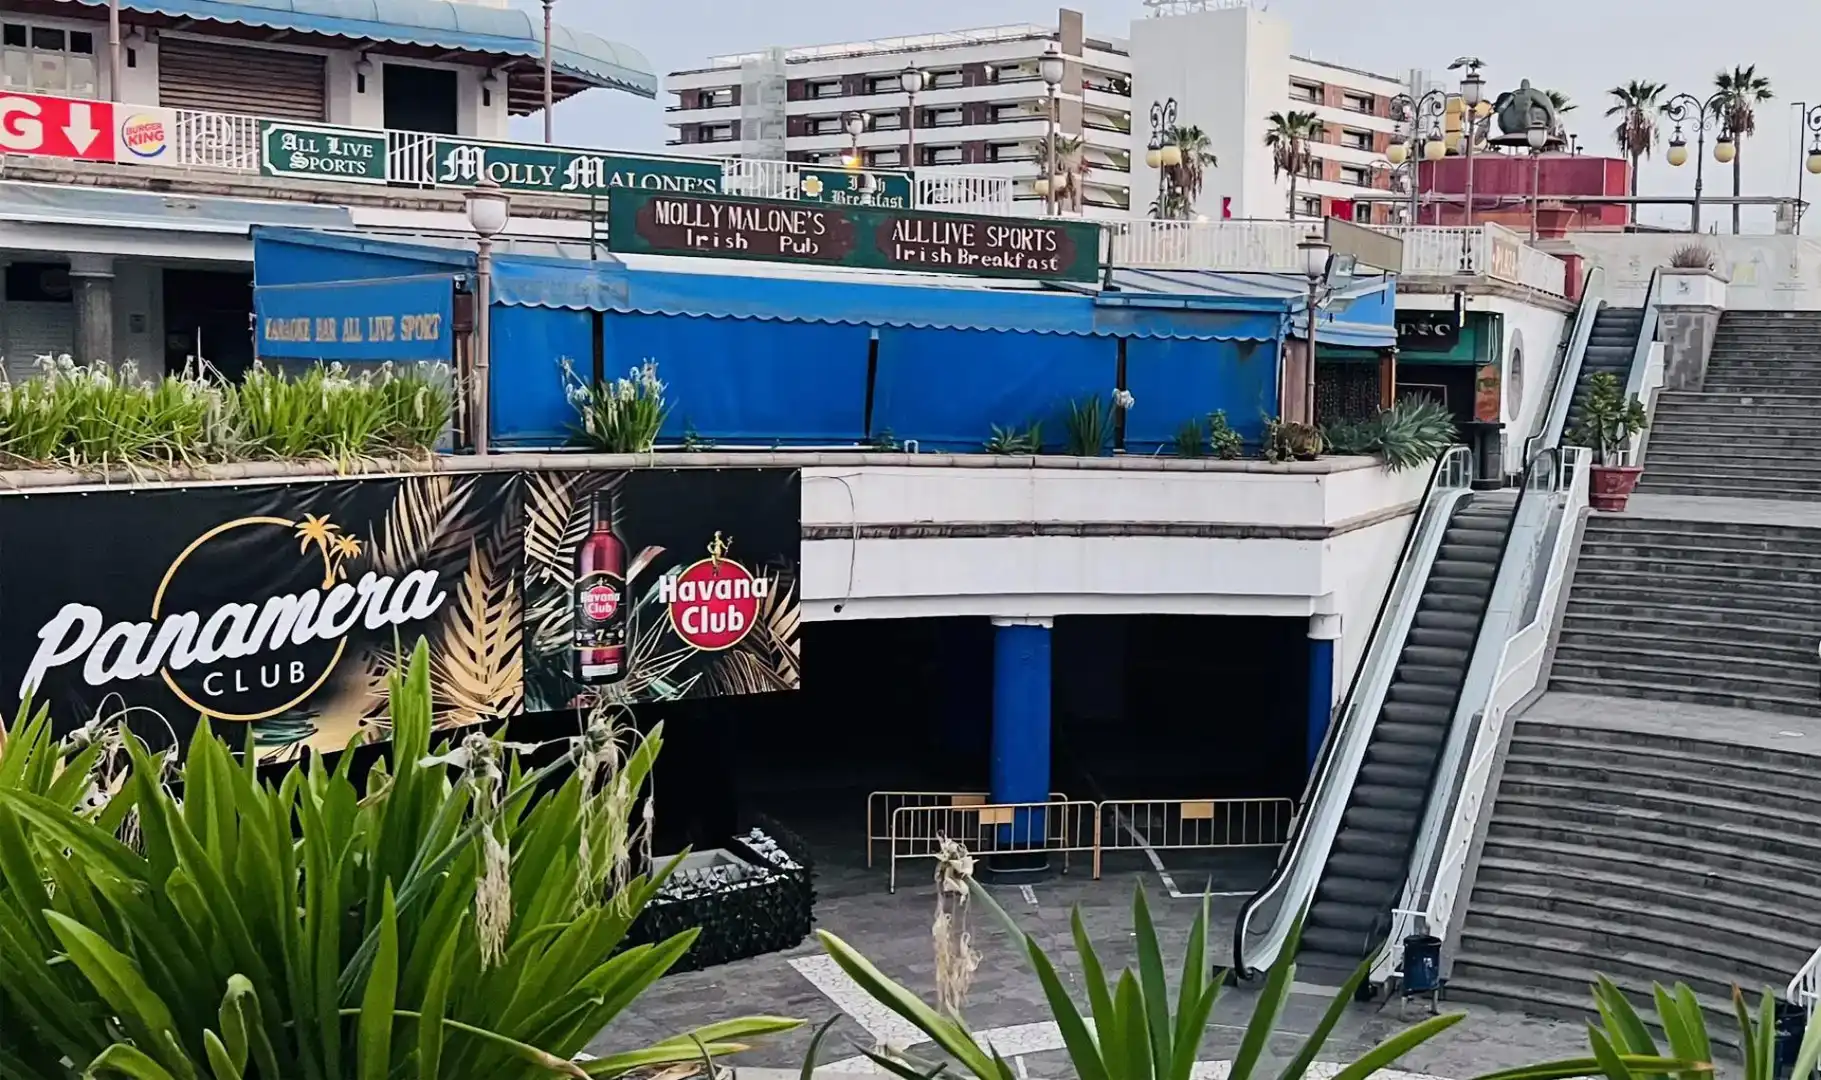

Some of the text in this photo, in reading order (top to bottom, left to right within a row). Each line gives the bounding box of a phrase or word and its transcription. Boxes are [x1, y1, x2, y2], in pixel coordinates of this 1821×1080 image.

[126, 122, 163, 136] BURGER
[128, 131, 165, 146] KING
[281, 133, 373, 158] ALL LIVE
[289, 151, 366, 174] SPORTS
[439, 145, 556, 186] MOLLY
[831, 189, 904, 209] Brekfast
[655, 200, 826, 236] MOLLY MALONE'S
[686, 228, 819, 254] Irish Pub
[892, 219, 1057, 251] ALL LIVE SPORTS
[896, 244, 1059, 271] Irish Breakfast
[316, 317, 337, 342] BAR
[342, 317, 363, 342] ALL
[368, 316, 395, 342] LIVE
[401, 313, 441, 341] SPORT
[580, 591, 620, 603] Havana
[659, 574, 768, 603] Havana
[588, 602, 612, 613] Club
[681, 604, 744, 634] Club
[19, 569, 446, 700] Panamera
[203, 660, 305, 696] CLUB
